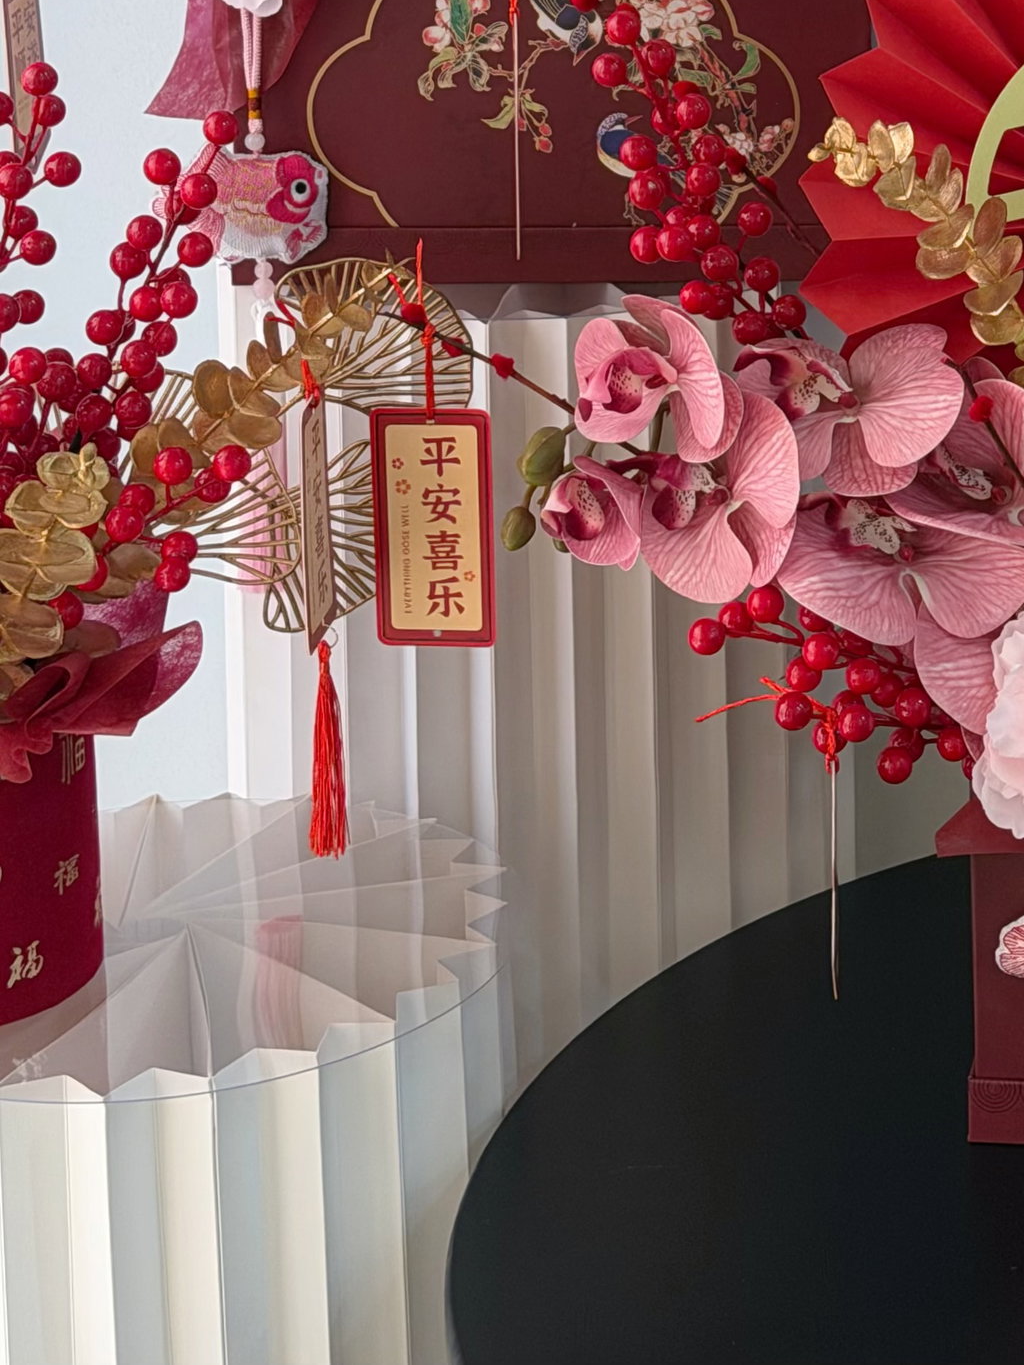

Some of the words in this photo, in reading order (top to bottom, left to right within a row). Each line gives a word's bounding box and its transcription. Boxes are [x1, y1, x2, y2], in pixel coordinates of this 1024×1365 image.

[401, 505, 410, 528] WELL
[420, 436, 466, 618] 平安喜乐
